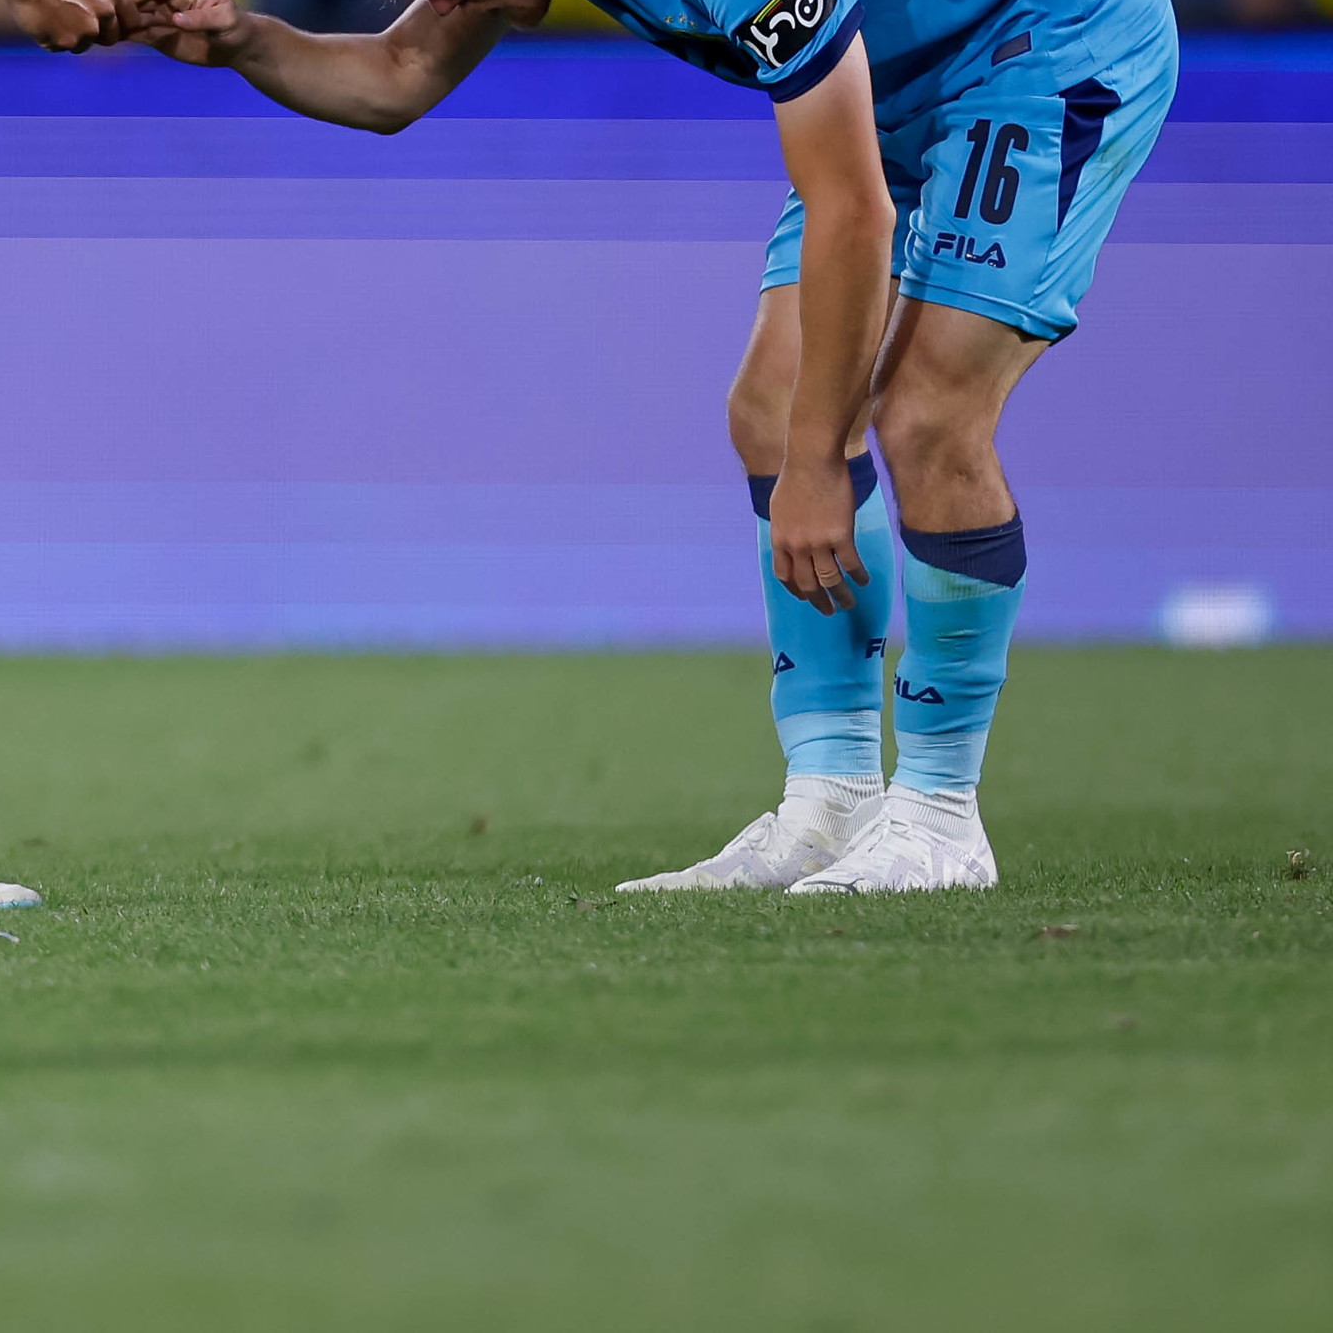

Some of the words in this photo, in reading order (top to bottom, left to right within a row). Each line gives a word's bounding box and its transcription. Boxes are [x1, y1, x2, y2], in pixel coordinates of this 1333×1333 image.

[953, 118, 1030, 225] 16
[933, 232, 1006, 269] FILA
[893, 674, 945, 706] ILA
